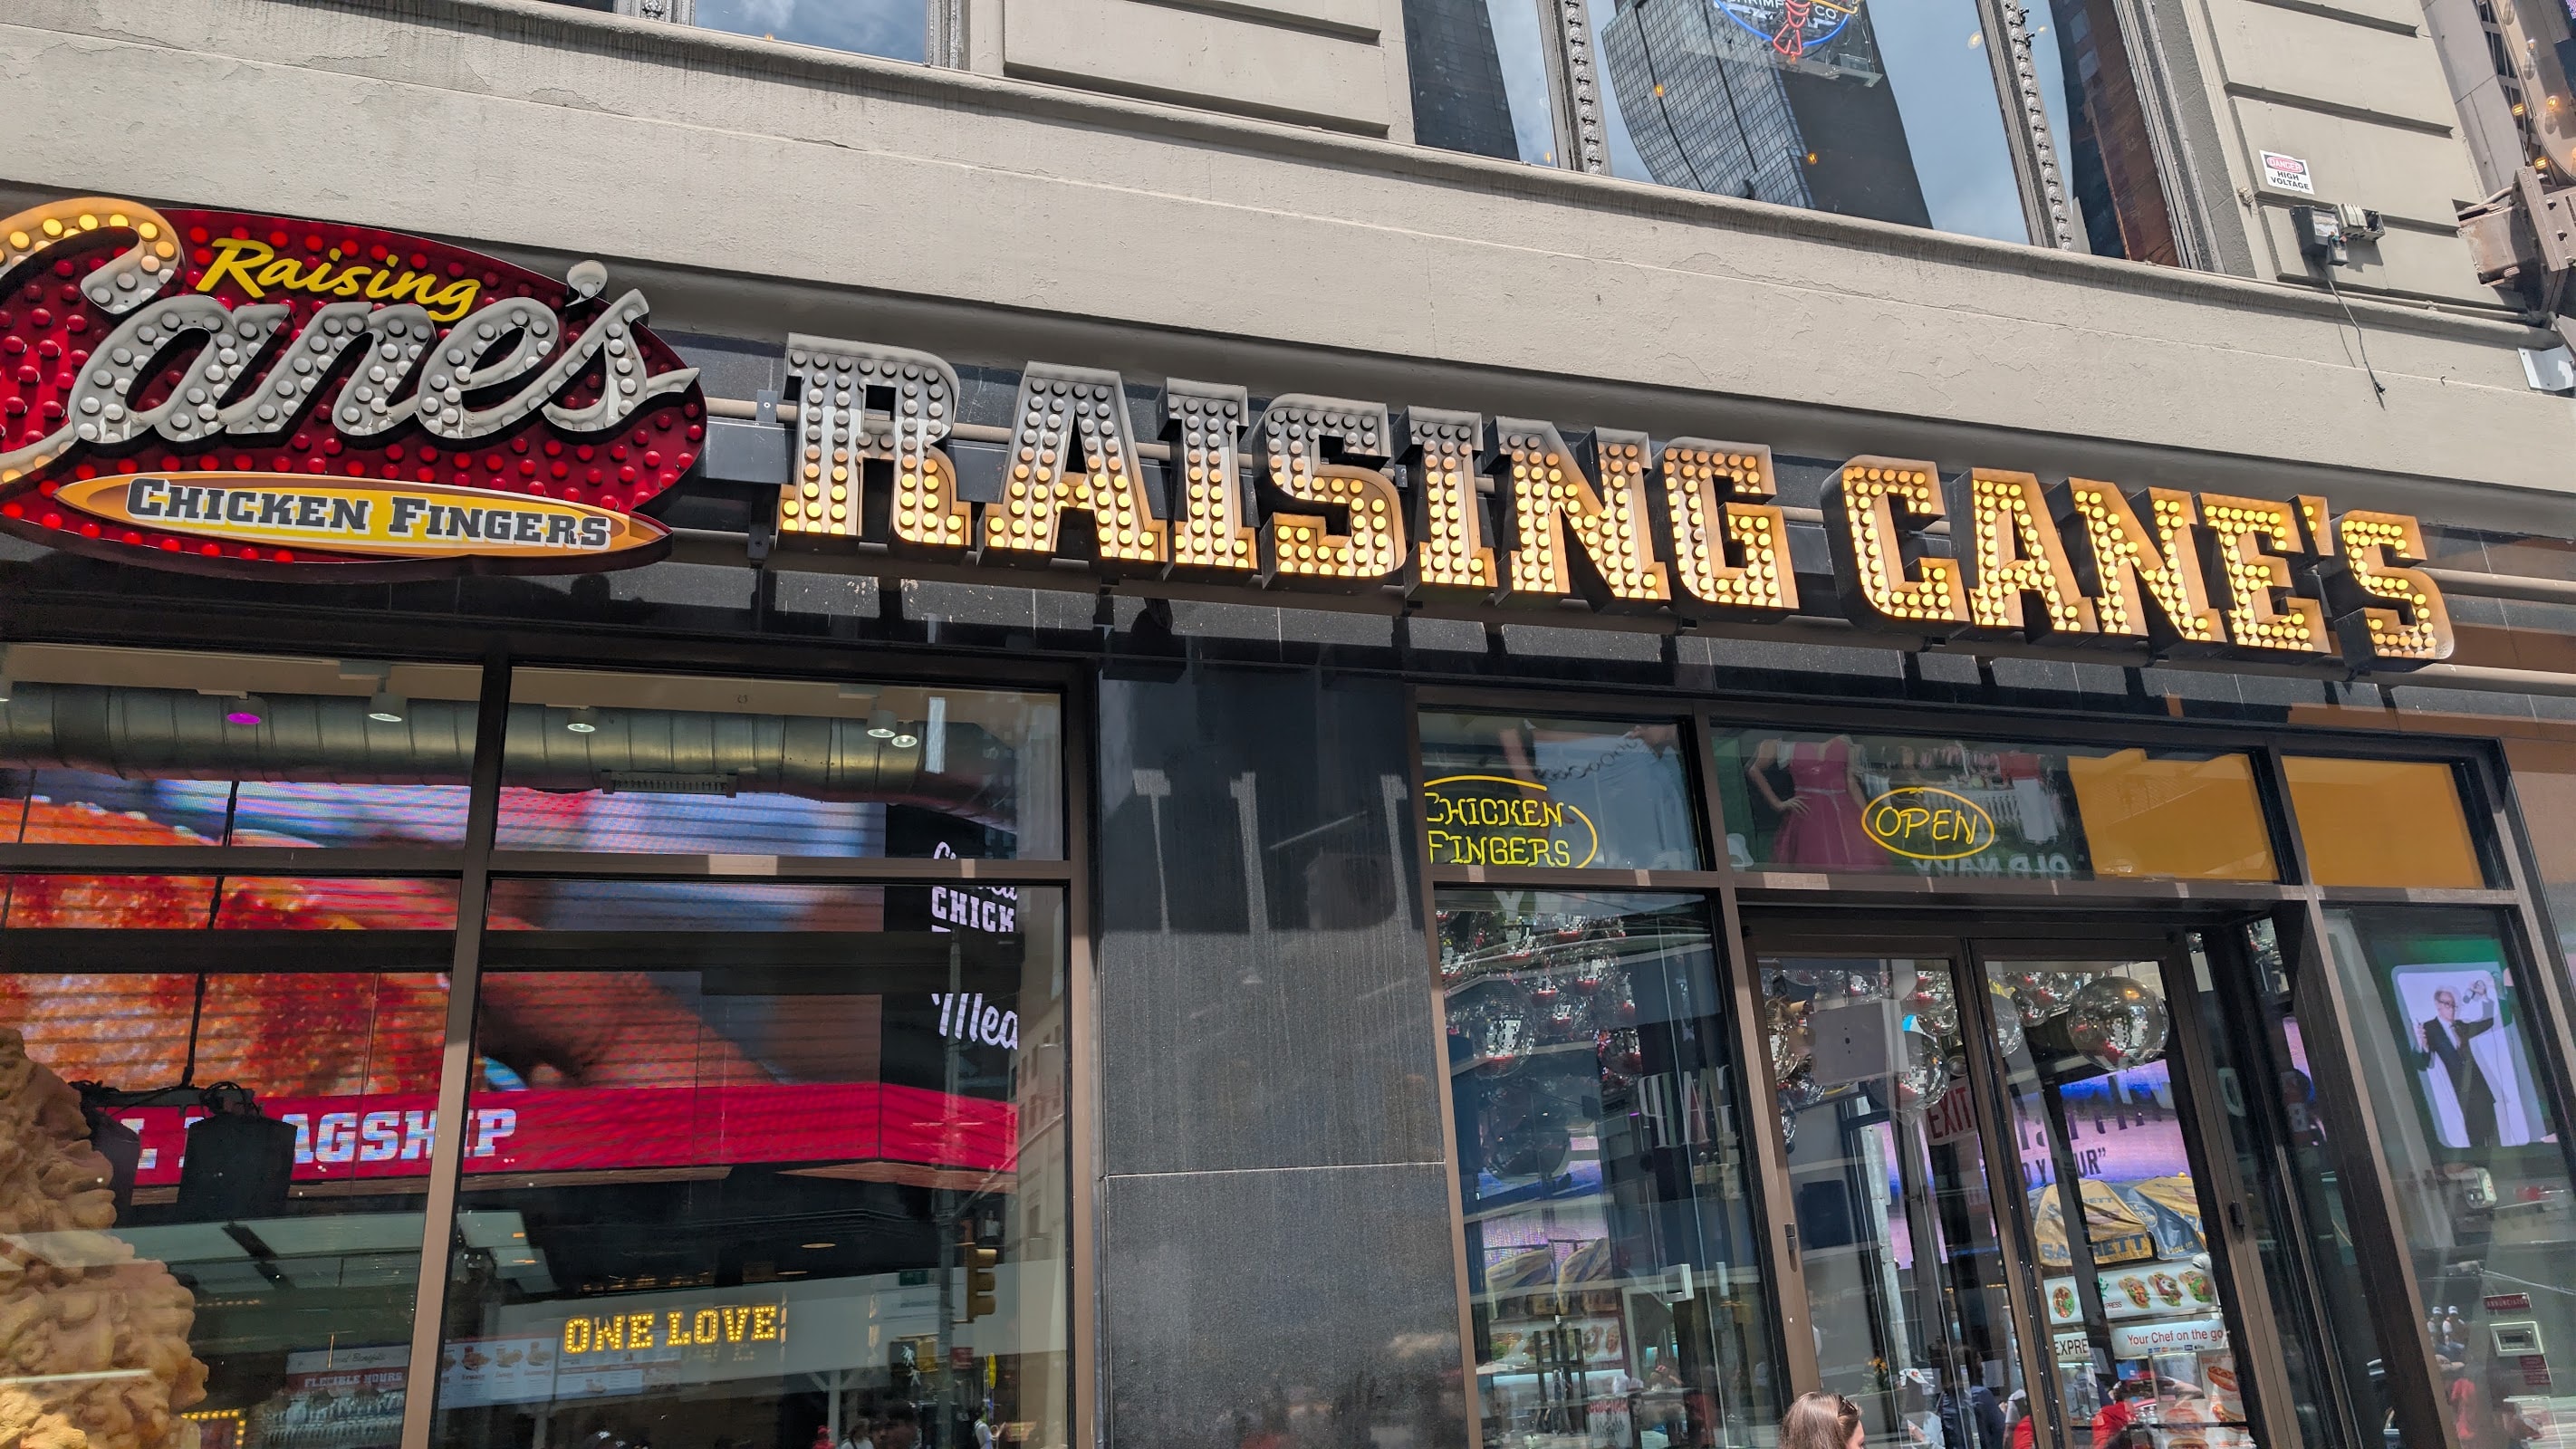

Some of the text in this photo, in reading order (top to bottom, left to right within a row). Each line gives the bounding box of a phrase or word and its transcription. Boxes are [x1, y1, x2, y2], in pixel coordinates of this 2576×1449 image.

[2269, 158, 2302, 170] DANGER
[2271, 177, 2309, 189] VOLTAGE
[2277, 171, 2299, 180] HIGH
[196, 236, 481, 322] Raising
[126, 478, 613, 550] CHICKEN FINGERS
[777, 331, 2456, 666] RAISING CANE'S
[1875, 806, 1977, 844] OPEN
[1427, 830, 1571, 867] FINGERS
[1927, 1087, 1972, 1139] EXIT
[179, 1108, 516, 1169] AGSHP
[564, 1305, 778, 1354] ONE LOVE
[2127, 1329, 2224, 1346] Your Chef on the go
